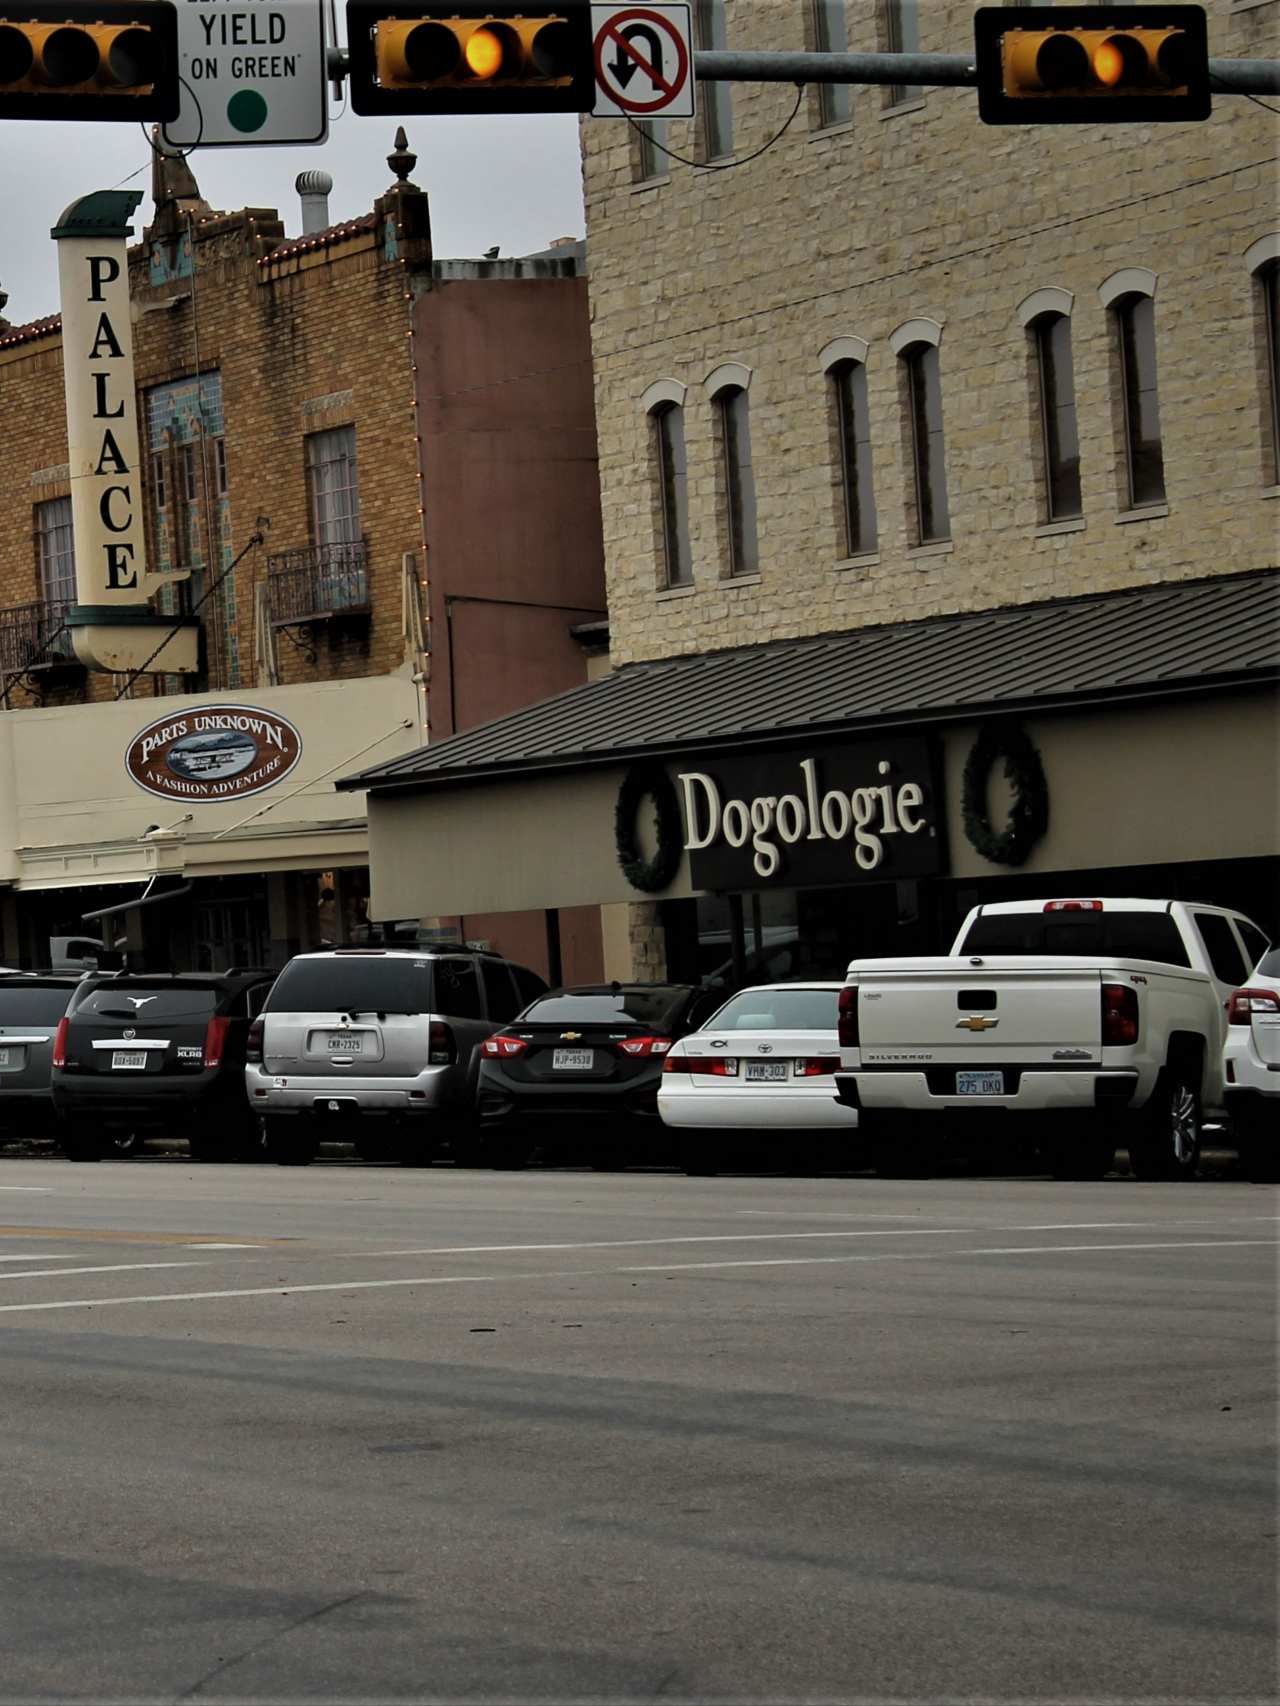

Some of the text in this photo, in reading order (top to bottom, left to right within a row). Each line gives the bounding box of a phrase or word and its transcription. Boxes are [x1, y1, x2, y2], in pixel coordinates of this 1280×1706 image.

[199, 13, 286, 46] YIELD
[191, 55, 296, 80] ON GREEN
[85, 255, 138, 590] PALACE
[140, 715, 283, 765] PARTS UNKNOWN
[145, 755, 282, 795] A FASHION ADVENTURE
[678, 758, 926, 877] Dogologie
[958, 1079, 1002, 1094] 275 DKQ
